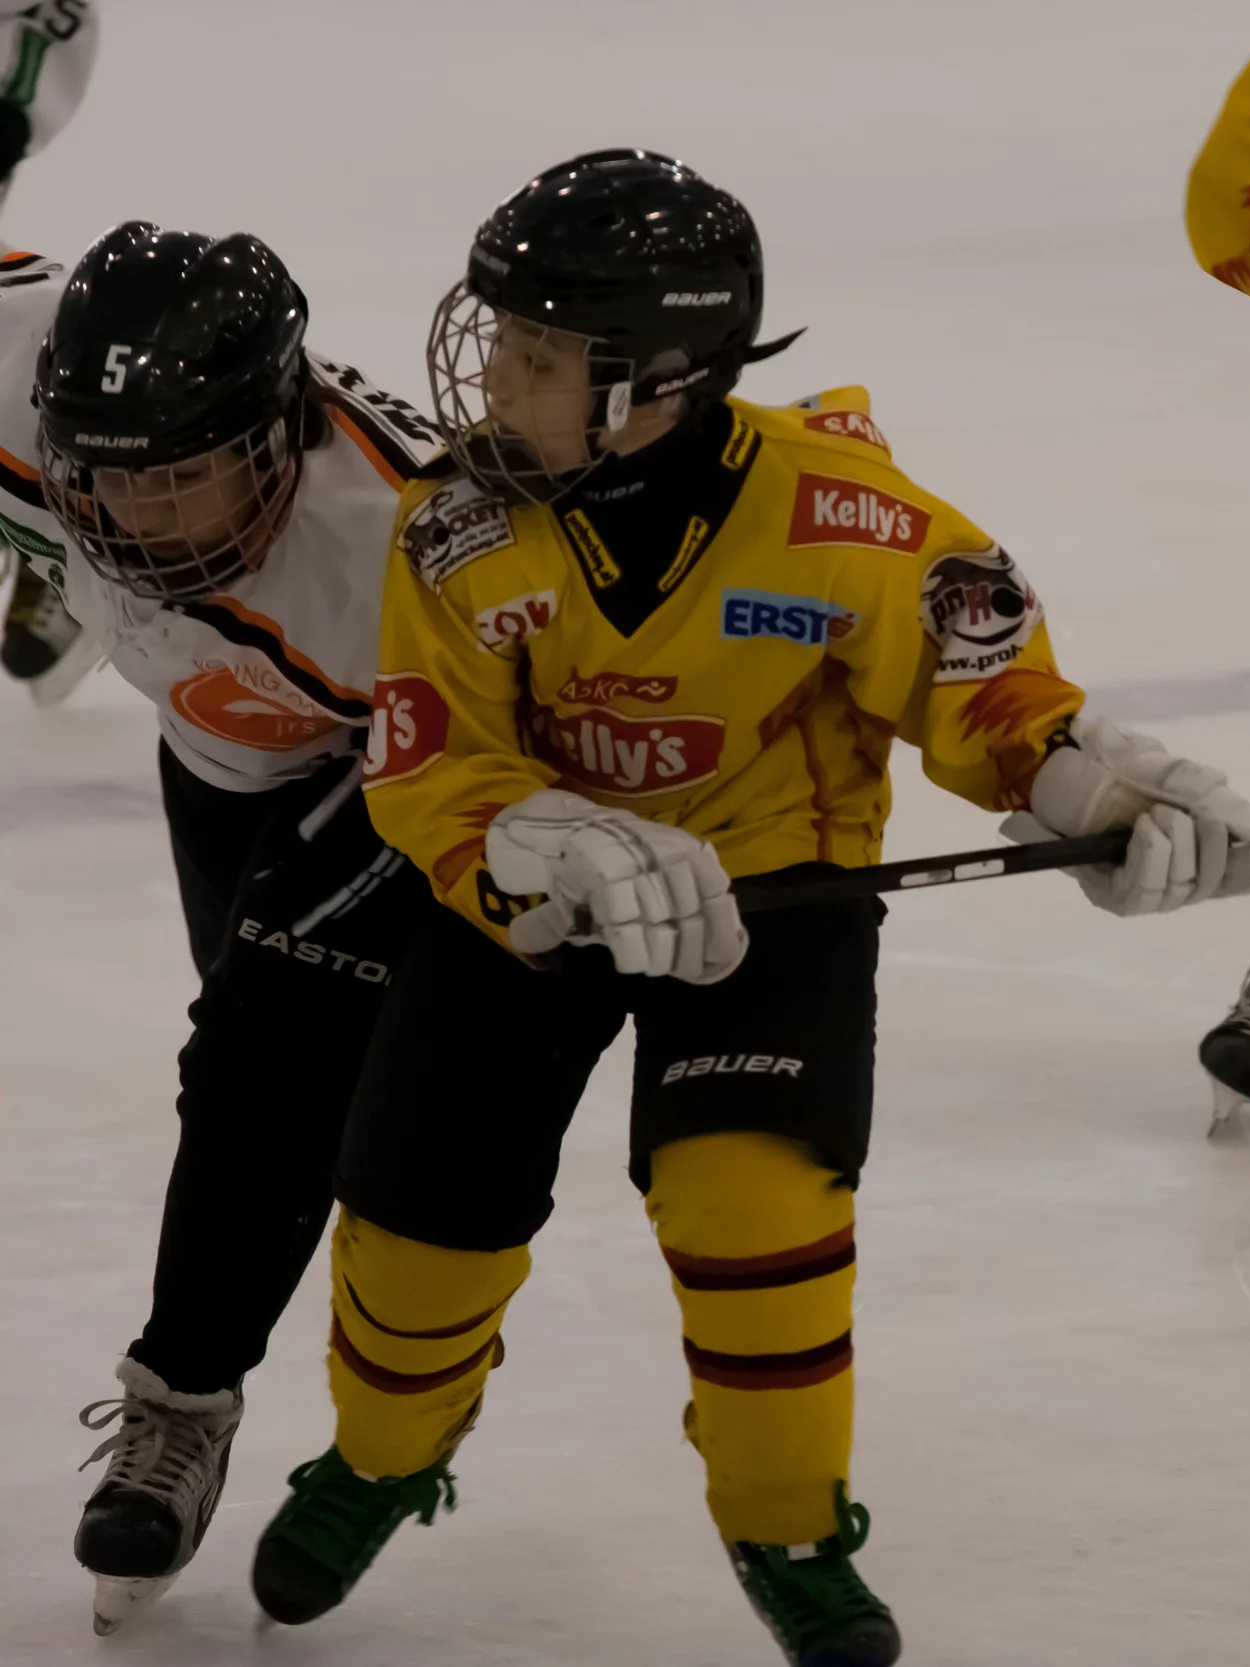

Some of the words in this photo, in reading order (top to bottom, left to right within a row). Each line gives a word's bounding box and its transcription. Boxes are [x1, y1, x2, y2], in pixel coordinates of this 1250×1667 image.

[101, 344, 132, 394] 5
[812, 488, 912, 543] Kelly's
[660, 1053, 805, 1087] BAUER
